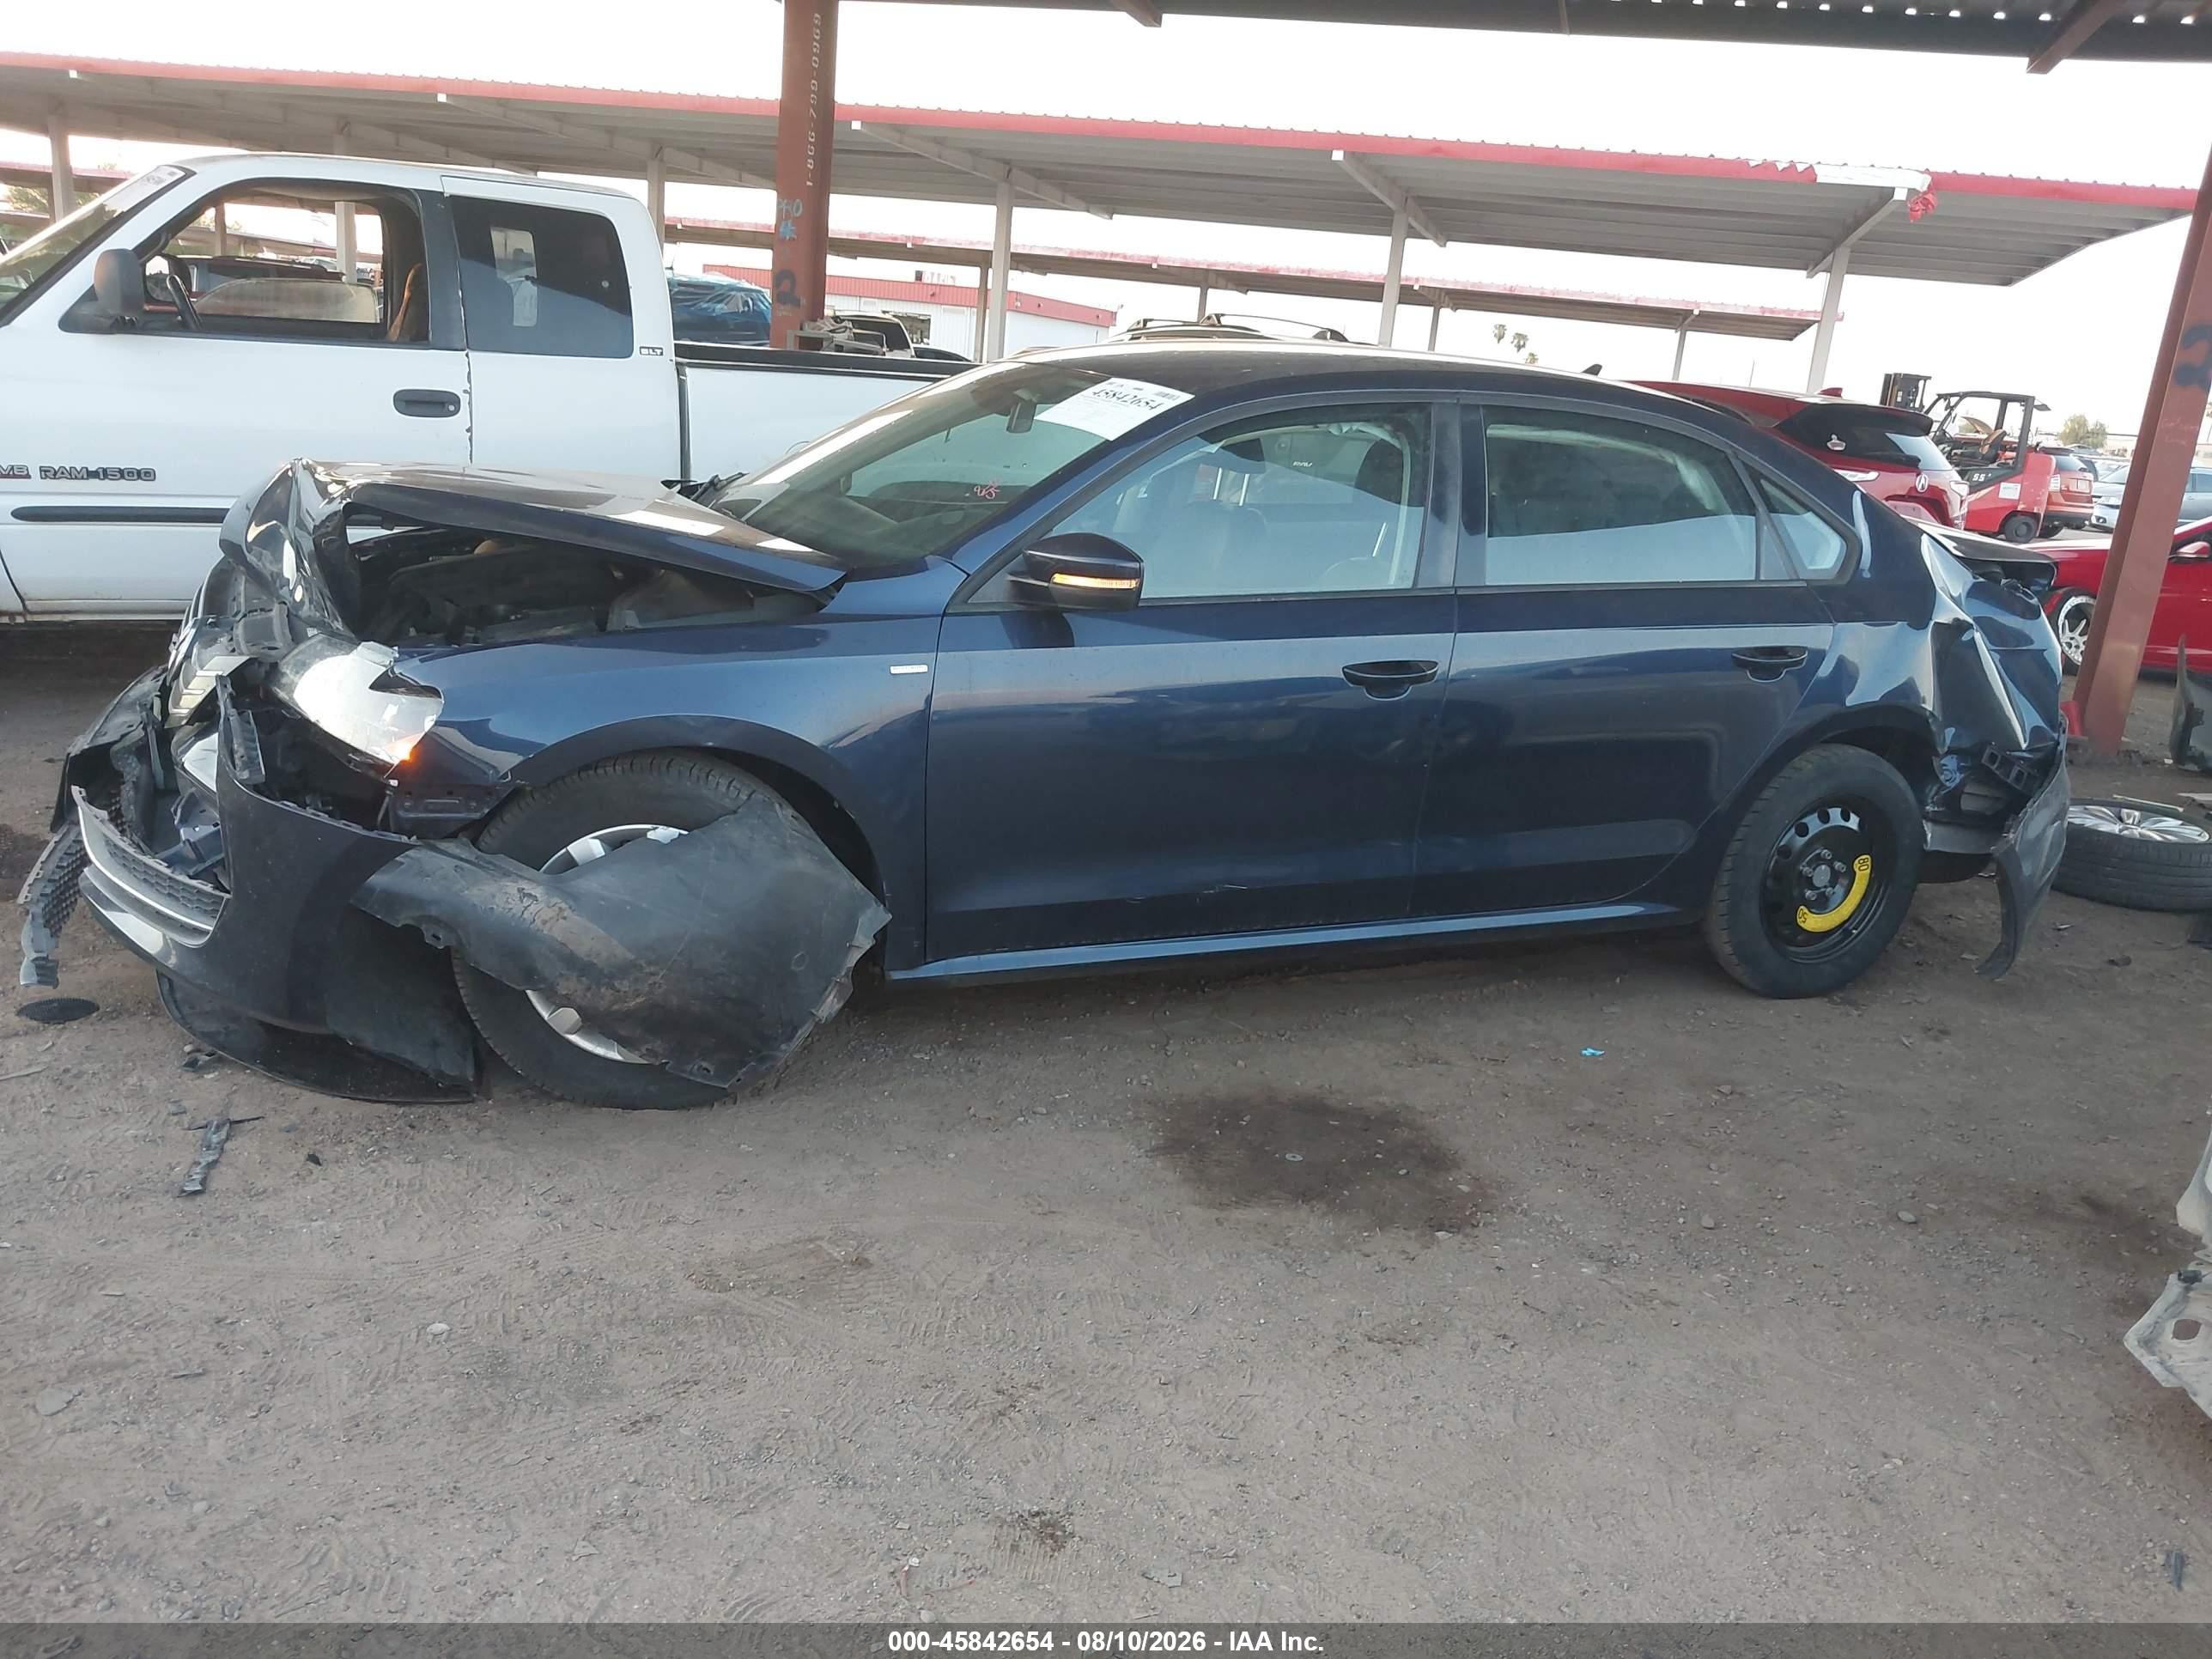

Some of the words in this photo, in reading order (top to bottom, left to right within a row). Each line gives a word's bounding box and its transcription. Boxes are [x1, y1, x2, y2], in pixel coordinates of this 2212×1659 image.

[805, 12, 822, 186] 1-866-799-0969
[775, 269, 801, 307] 2
[639, 346, 664, 356] SLT
[2175, 323, 2212, 389] 2
[1857, 857, 1869, 872] 80
